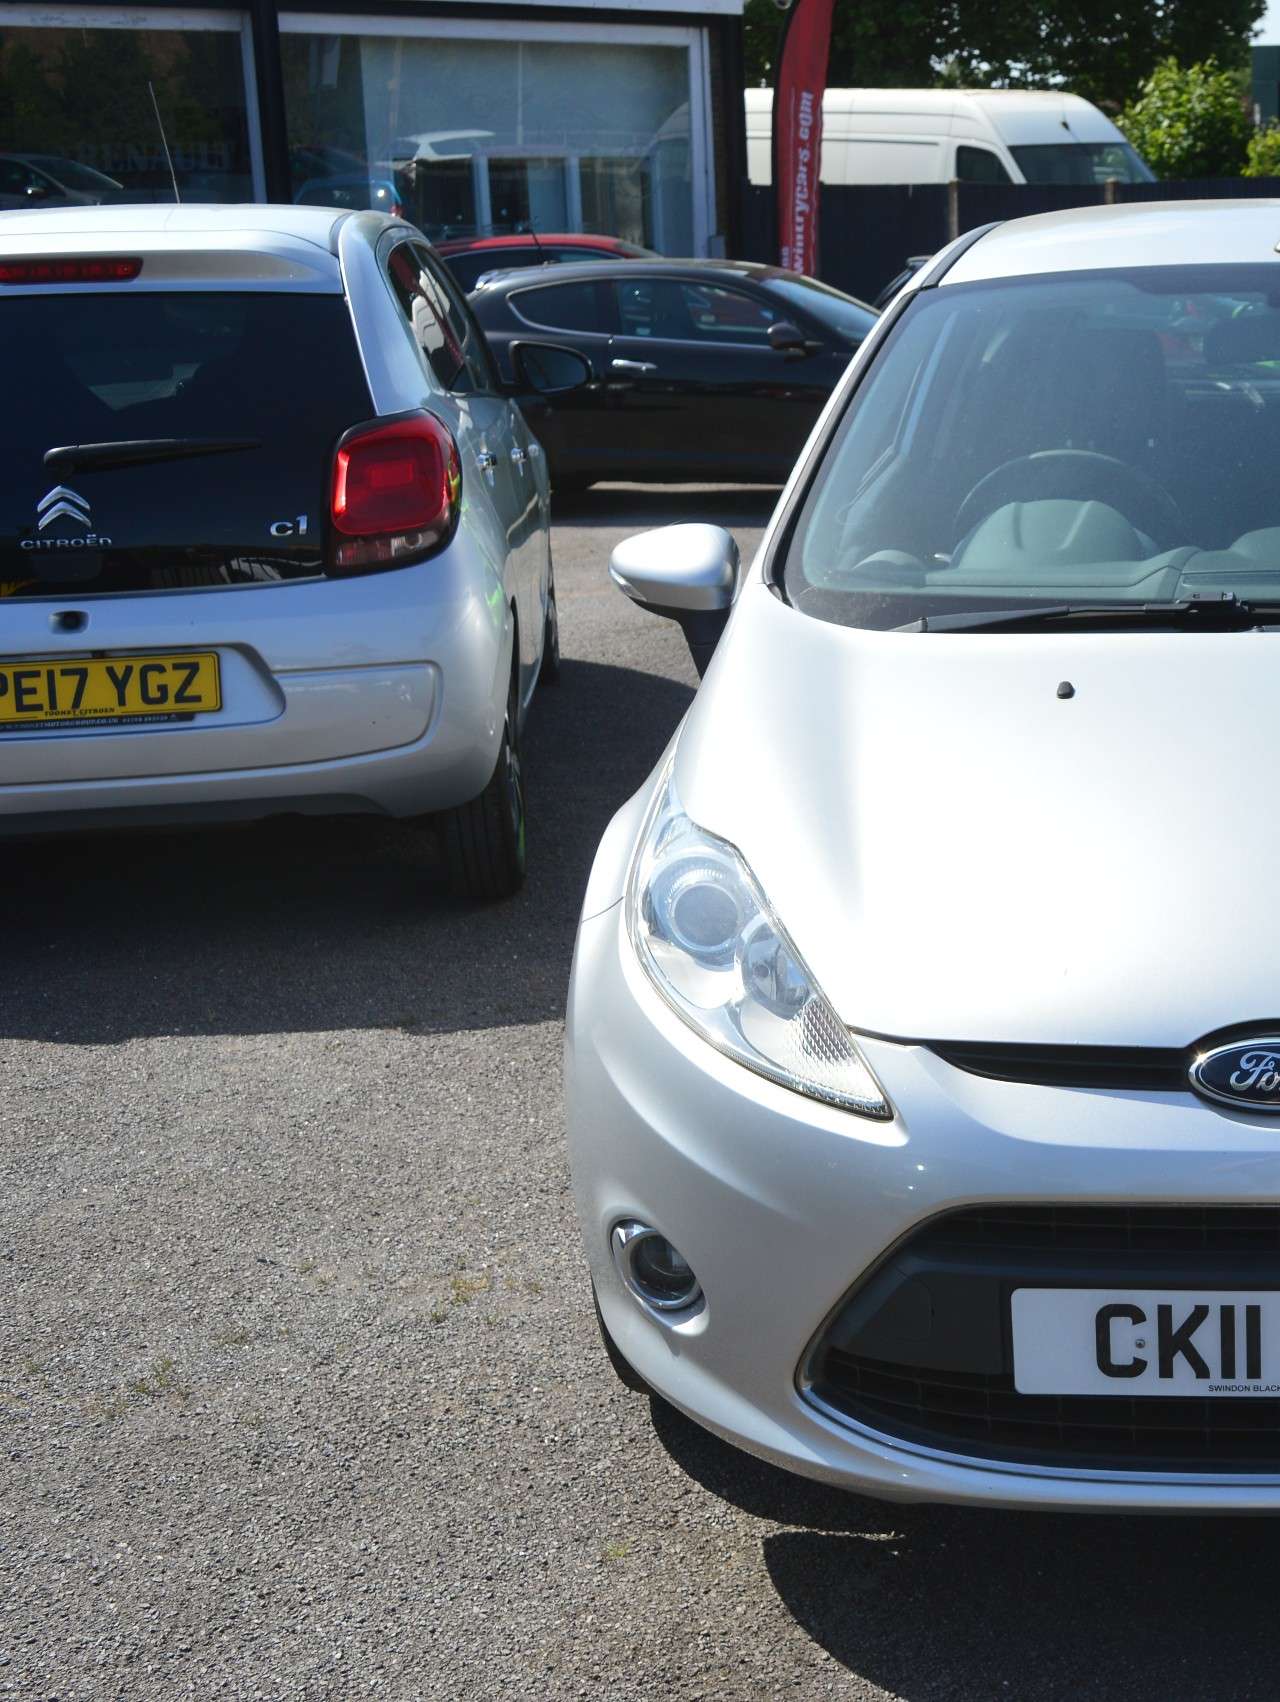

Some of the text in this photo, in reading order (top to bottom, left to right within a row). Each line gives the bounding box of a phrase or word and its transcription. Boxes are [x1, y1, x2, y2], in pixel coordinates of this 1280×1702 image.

[105, 662, 203, 707] YGZ
[1096, 1303, 1262, 1379] CK11
[1208, 1384, 1250, 1392] SWINDON
